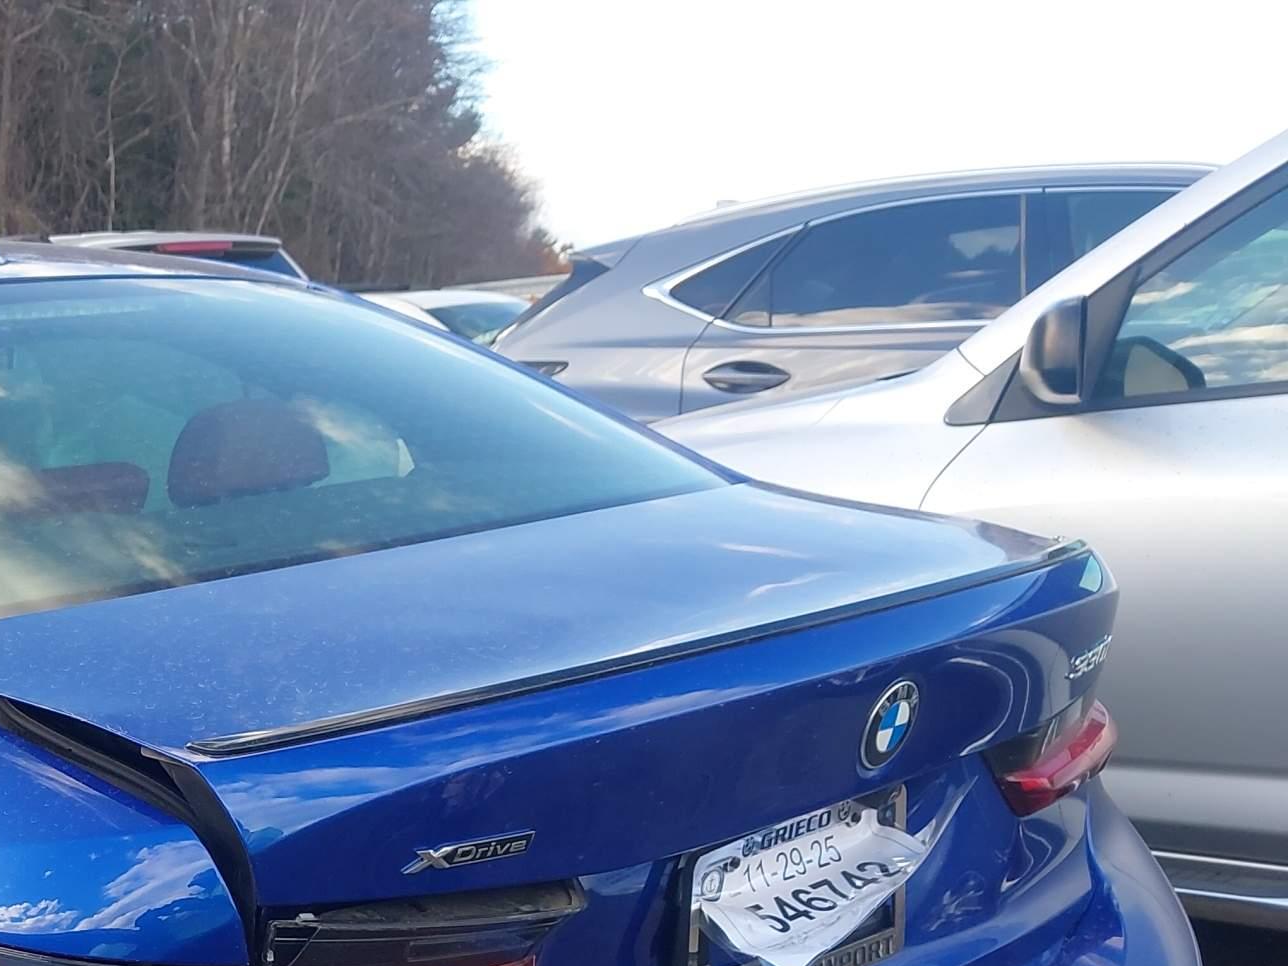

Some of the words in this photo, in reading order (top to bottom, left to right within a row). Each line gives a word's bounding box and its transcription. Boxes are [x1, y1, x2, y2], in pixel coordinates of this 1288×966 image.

[878, 684, 920, 717] BMW
[760, 808, 833, 851] GRIECO
[743, 834, 843, 892] 11-29-25
[743, 860, 903, 934] 546742
